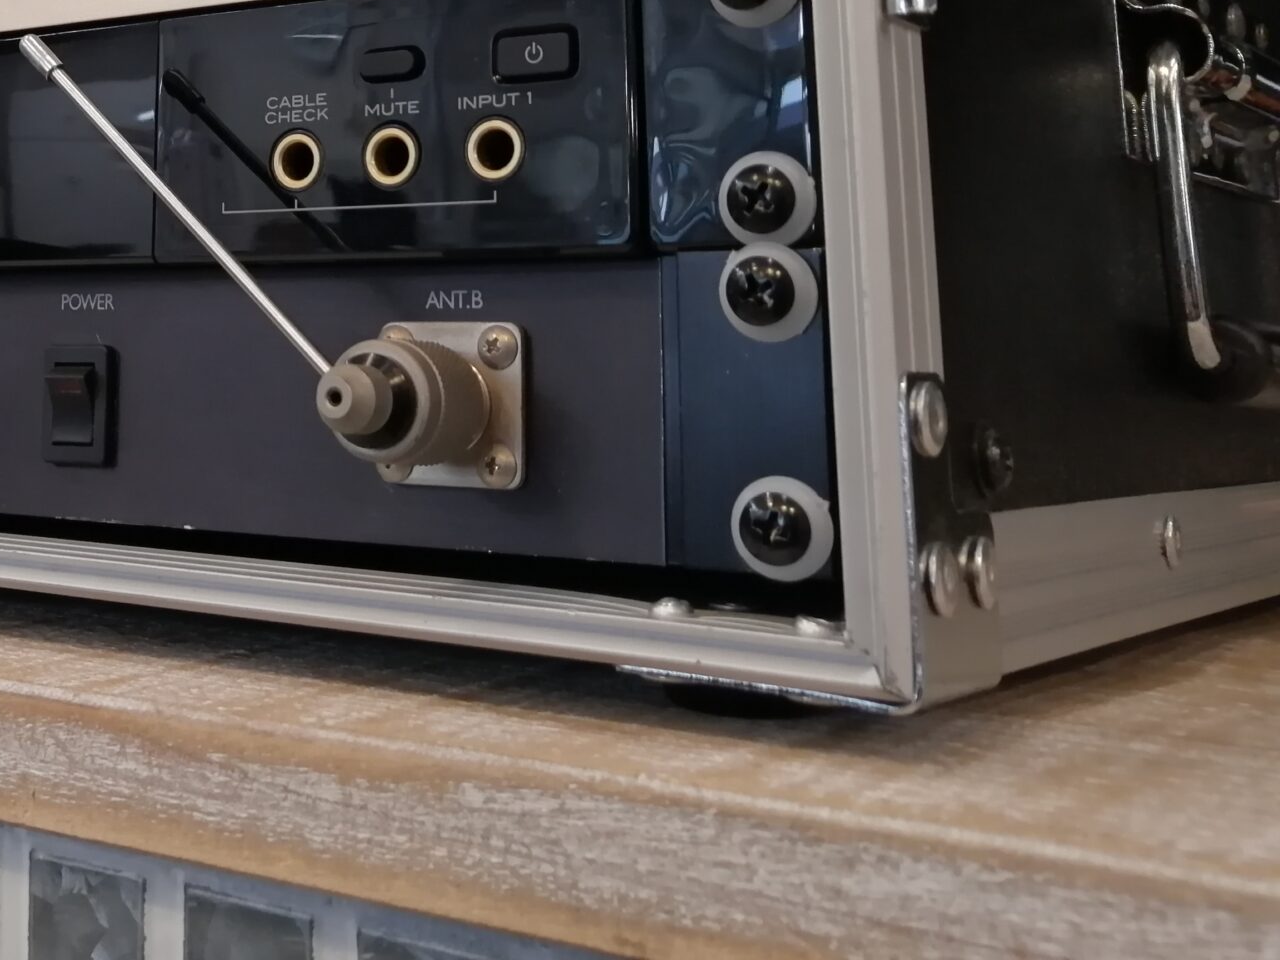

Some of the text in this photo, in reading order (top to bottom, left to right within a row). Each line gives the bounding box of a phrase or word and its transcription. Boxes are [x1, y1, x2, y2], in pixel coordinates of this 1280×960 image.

[266, 92, 327, 110] CABLE
[363, 100, 420, 117] MUTE
[457, 92, 519, 111] INPUT
[264, 108, 329, 125] CHECK
[60, 293, 115, 311] POWER
[426, 290, 484, 309] ANT.B
